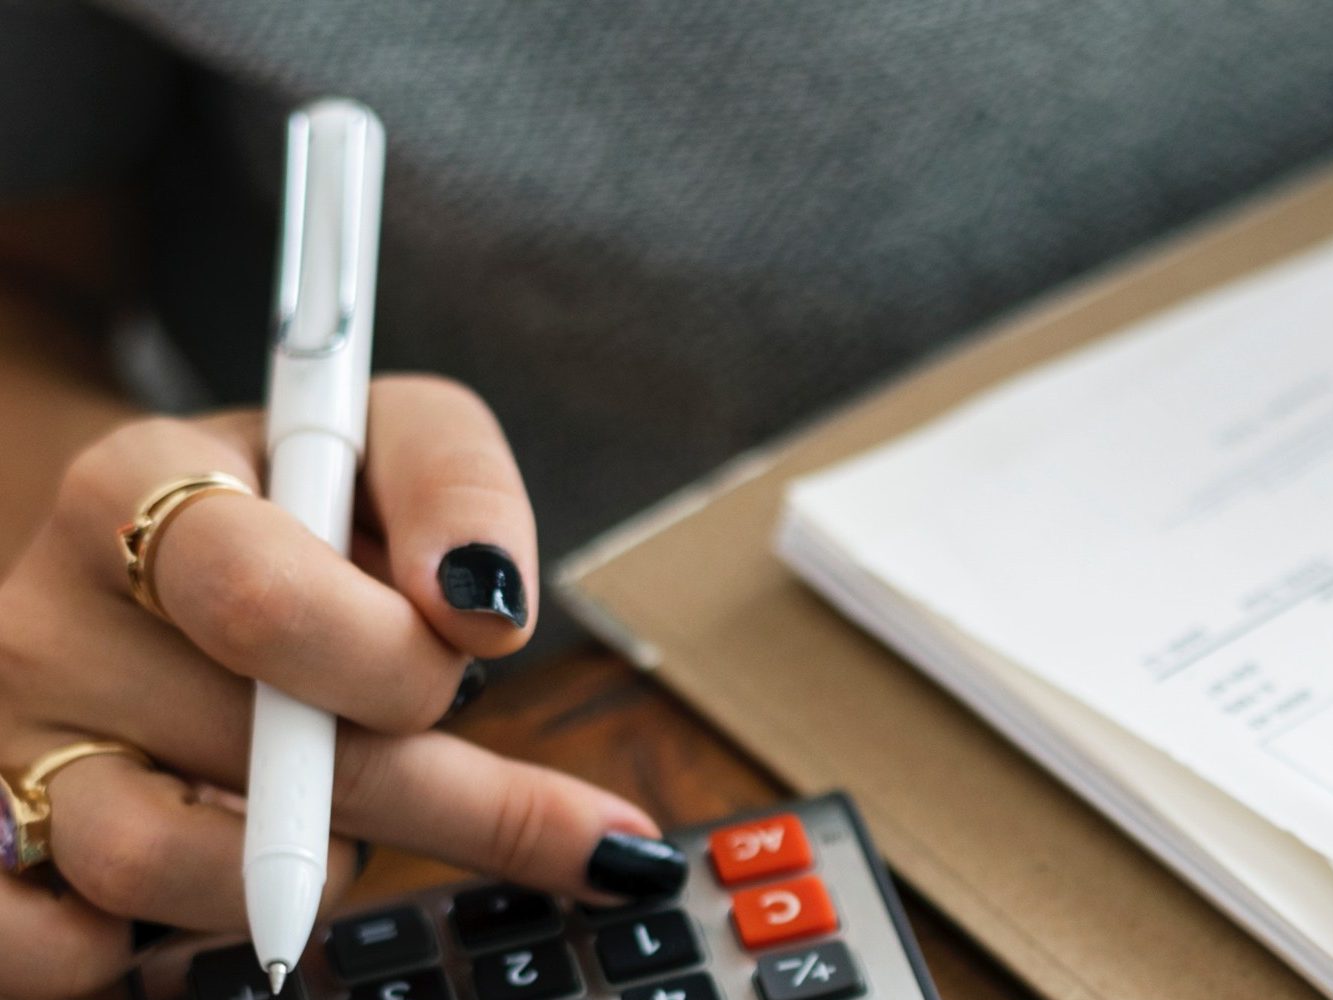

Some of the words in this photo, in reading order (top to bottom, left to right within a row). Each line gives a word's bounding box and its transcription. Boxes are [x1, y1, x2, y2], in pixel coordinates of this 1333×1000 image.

[726, 826, 785, 862] AC
[759, 890, 802, 926] C
[633, 923, 662, 956] 1
[503, 951, 539, 987] 2
